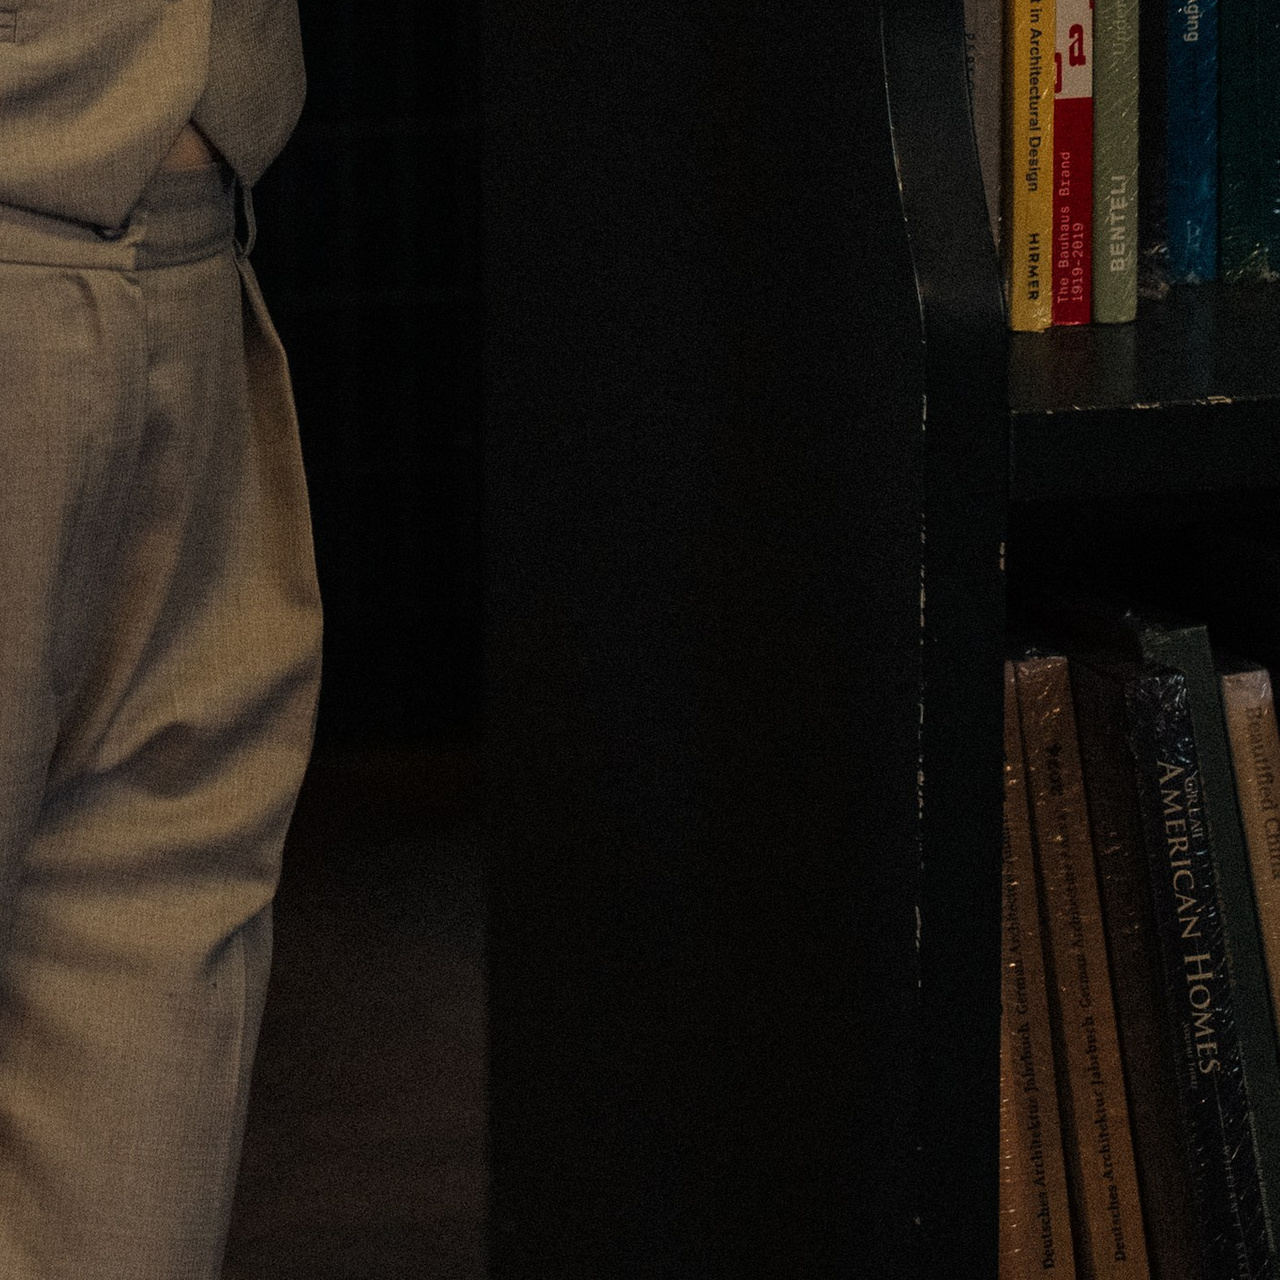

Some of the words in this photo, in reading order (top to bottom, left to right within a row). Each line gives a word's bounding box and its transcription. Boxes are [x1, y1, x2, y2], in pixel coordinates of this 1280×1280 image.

[1030, 8, 1043, 23] in
[1029, 27, 1043, 131] Architectural
[1026, 136, 1041, 192] Design
[1058, 151, 1071, 197] Brand
[1057, 205, 1070, 268] Bauhaus
[1109, 174, 1126, 273] BENTELI
[1028, 233, 1040, 301] HIRMER
[1057, 272, 1070, 303] The
[1072, 222, 1084, 302] 1919-2019
[1246, 706, 1277, 812] Beautified
[1264, 818, 1280, 881] China
[1156, 760, 1201, 940] AMERICAN
[1183, 952, 1221, 1075] HOMES
[1075, 953, 1091, 1008] German
[1019, 1021, 1038, 1092] Jahrbuch
[1083, 1015, 1103, 1085] Jahrbuch
[1028, 1097, 1046, 1187] Architektur
[1096, 1089, 1114, 1181] Architektur
[1037, 1191, 1056, 1269] Deutsches
[1107, 1184, 1126, 1262] Deutsches
